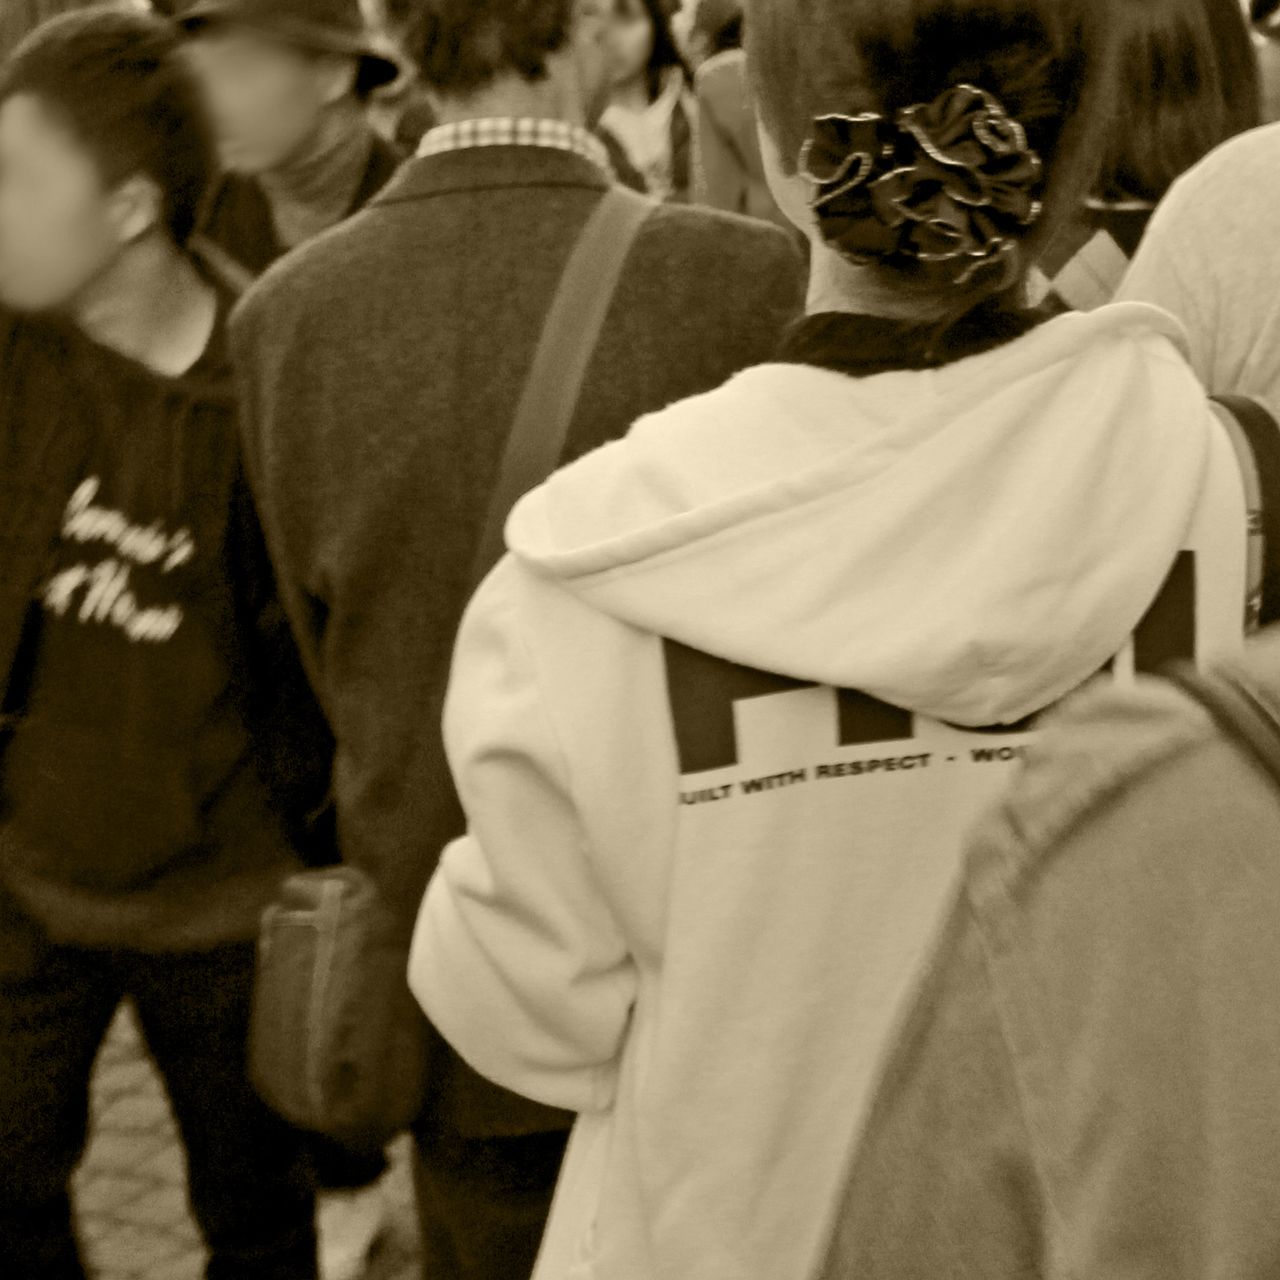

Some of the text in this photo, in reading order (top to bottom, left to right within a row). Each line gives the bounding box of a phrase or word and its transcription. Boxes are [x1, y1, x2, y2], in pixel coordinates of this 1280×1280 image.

[679, 782, 734, 806] UILT
[741, 767, 808, 795] WITH
[815, 752, 931, 781] RESPECT
